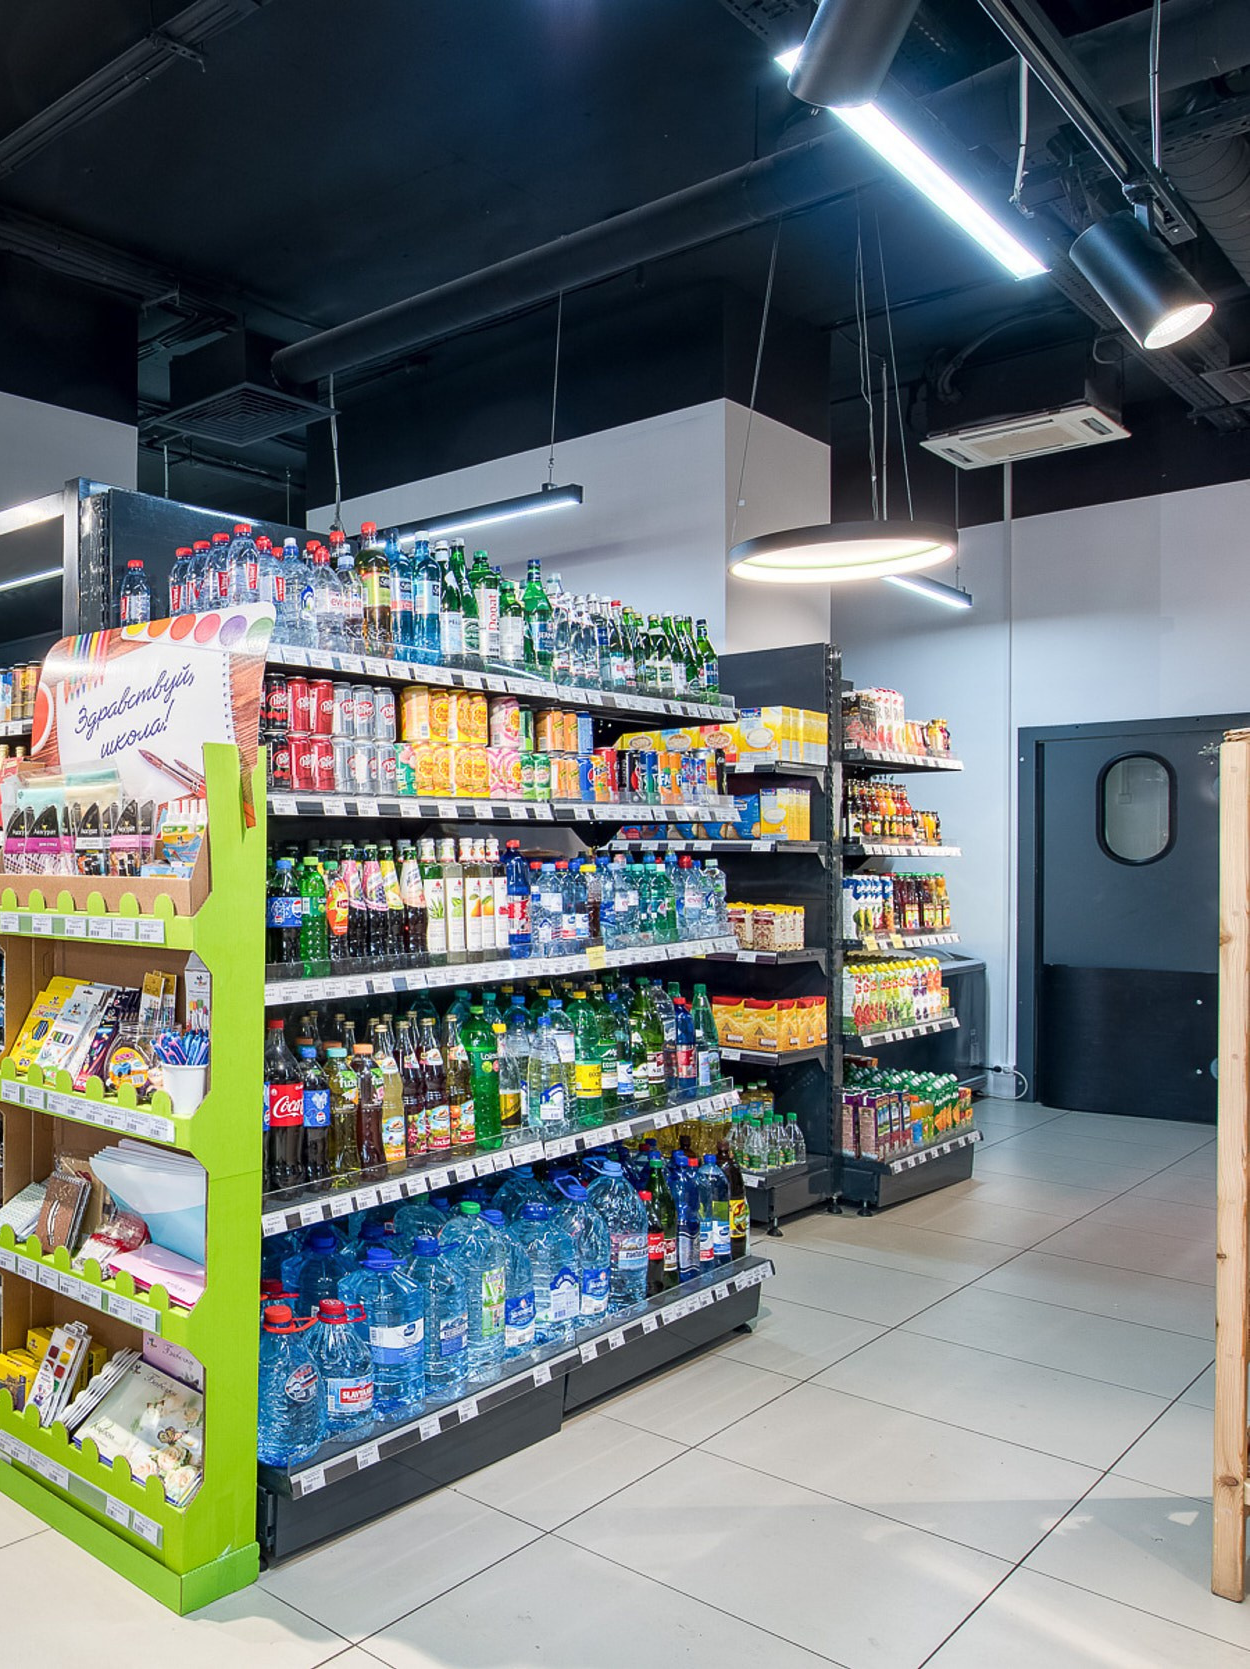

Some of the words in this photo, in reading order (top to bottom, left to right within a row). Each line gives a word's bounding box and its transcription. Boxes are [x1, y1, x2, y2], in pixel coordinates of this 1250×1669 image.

[488, 594, 497, 631] Donat
[74, 663, 196, 741] Здравствуй,
[100, 699, 175, 759] школа!
